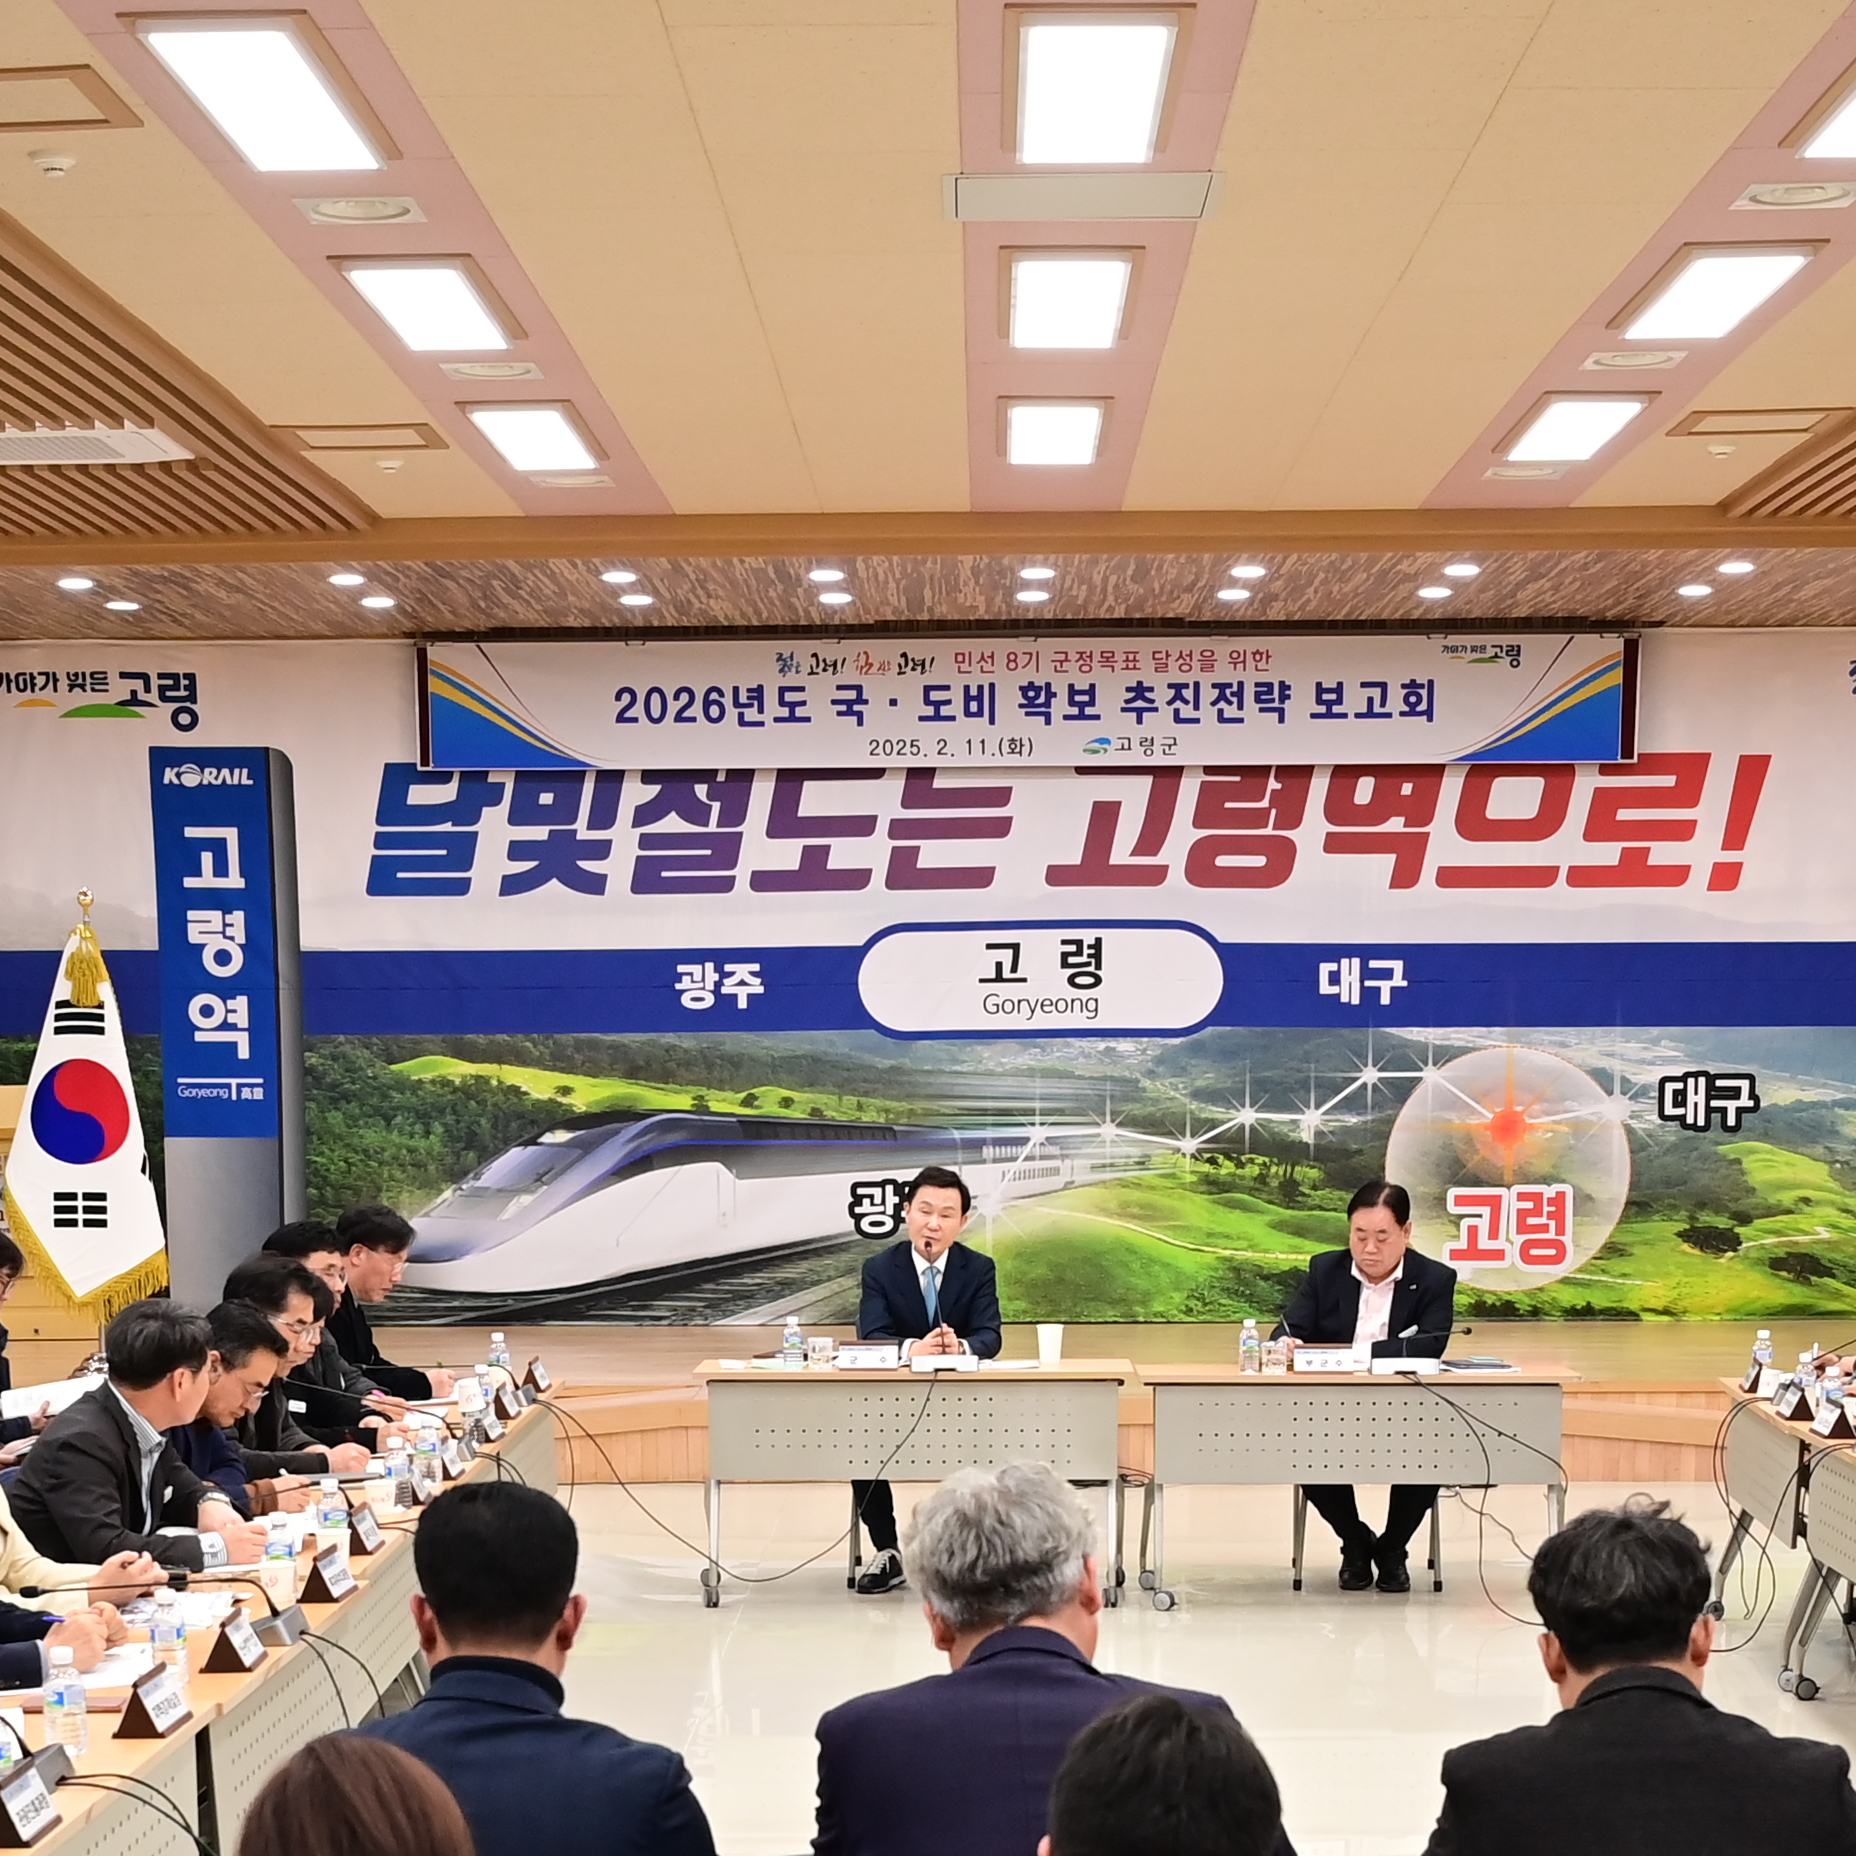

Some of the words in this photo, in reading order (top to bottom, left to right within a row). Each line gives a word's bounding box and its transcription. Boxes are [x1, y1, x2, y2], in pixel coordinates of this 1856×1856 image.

[953, 651, 998, 674] 민선
[1005, 650, 1041, 673] 8기
[1050, 649, 1143, 674] 군정목표
[1151, 649, 1219, 673] 달성을
[1227, 648, 1273, 672] 위한
[1488, 644, 1521, 669] 고령
[117, 671, 200, 733] 고령
[614, 683, 812, 727] 2026년도
[1018, 681, 1102, 726] 확보
[1120, 680, 1292, 726] 추진전략
[1310, 678, 1436, 723] 보고회
[869, 738, 929, 758] 2025.
[936, 738, 956, 758] 2.
[1114, 736, 1179, 757] 고령군
[162, 763, 254, 788] KORAIL
[1044, 752, 1773, 891] 고령역으로!
[182, 825, 251, 1060] 고령역
[977, 936, 1105, 989] 고령
[674, 962, 765, 1009] 광주
[1318, 958, 1408, 1006] 대구
[982, 993, 1100, 1020] Goryeong
[177, 1085, 229, 1099] Goryeong
[1661, 1074, 1756, 1129] 대구
[850, 1180, 910, 1238] 광
[1447, 1188, 1569, 1268] 고령
